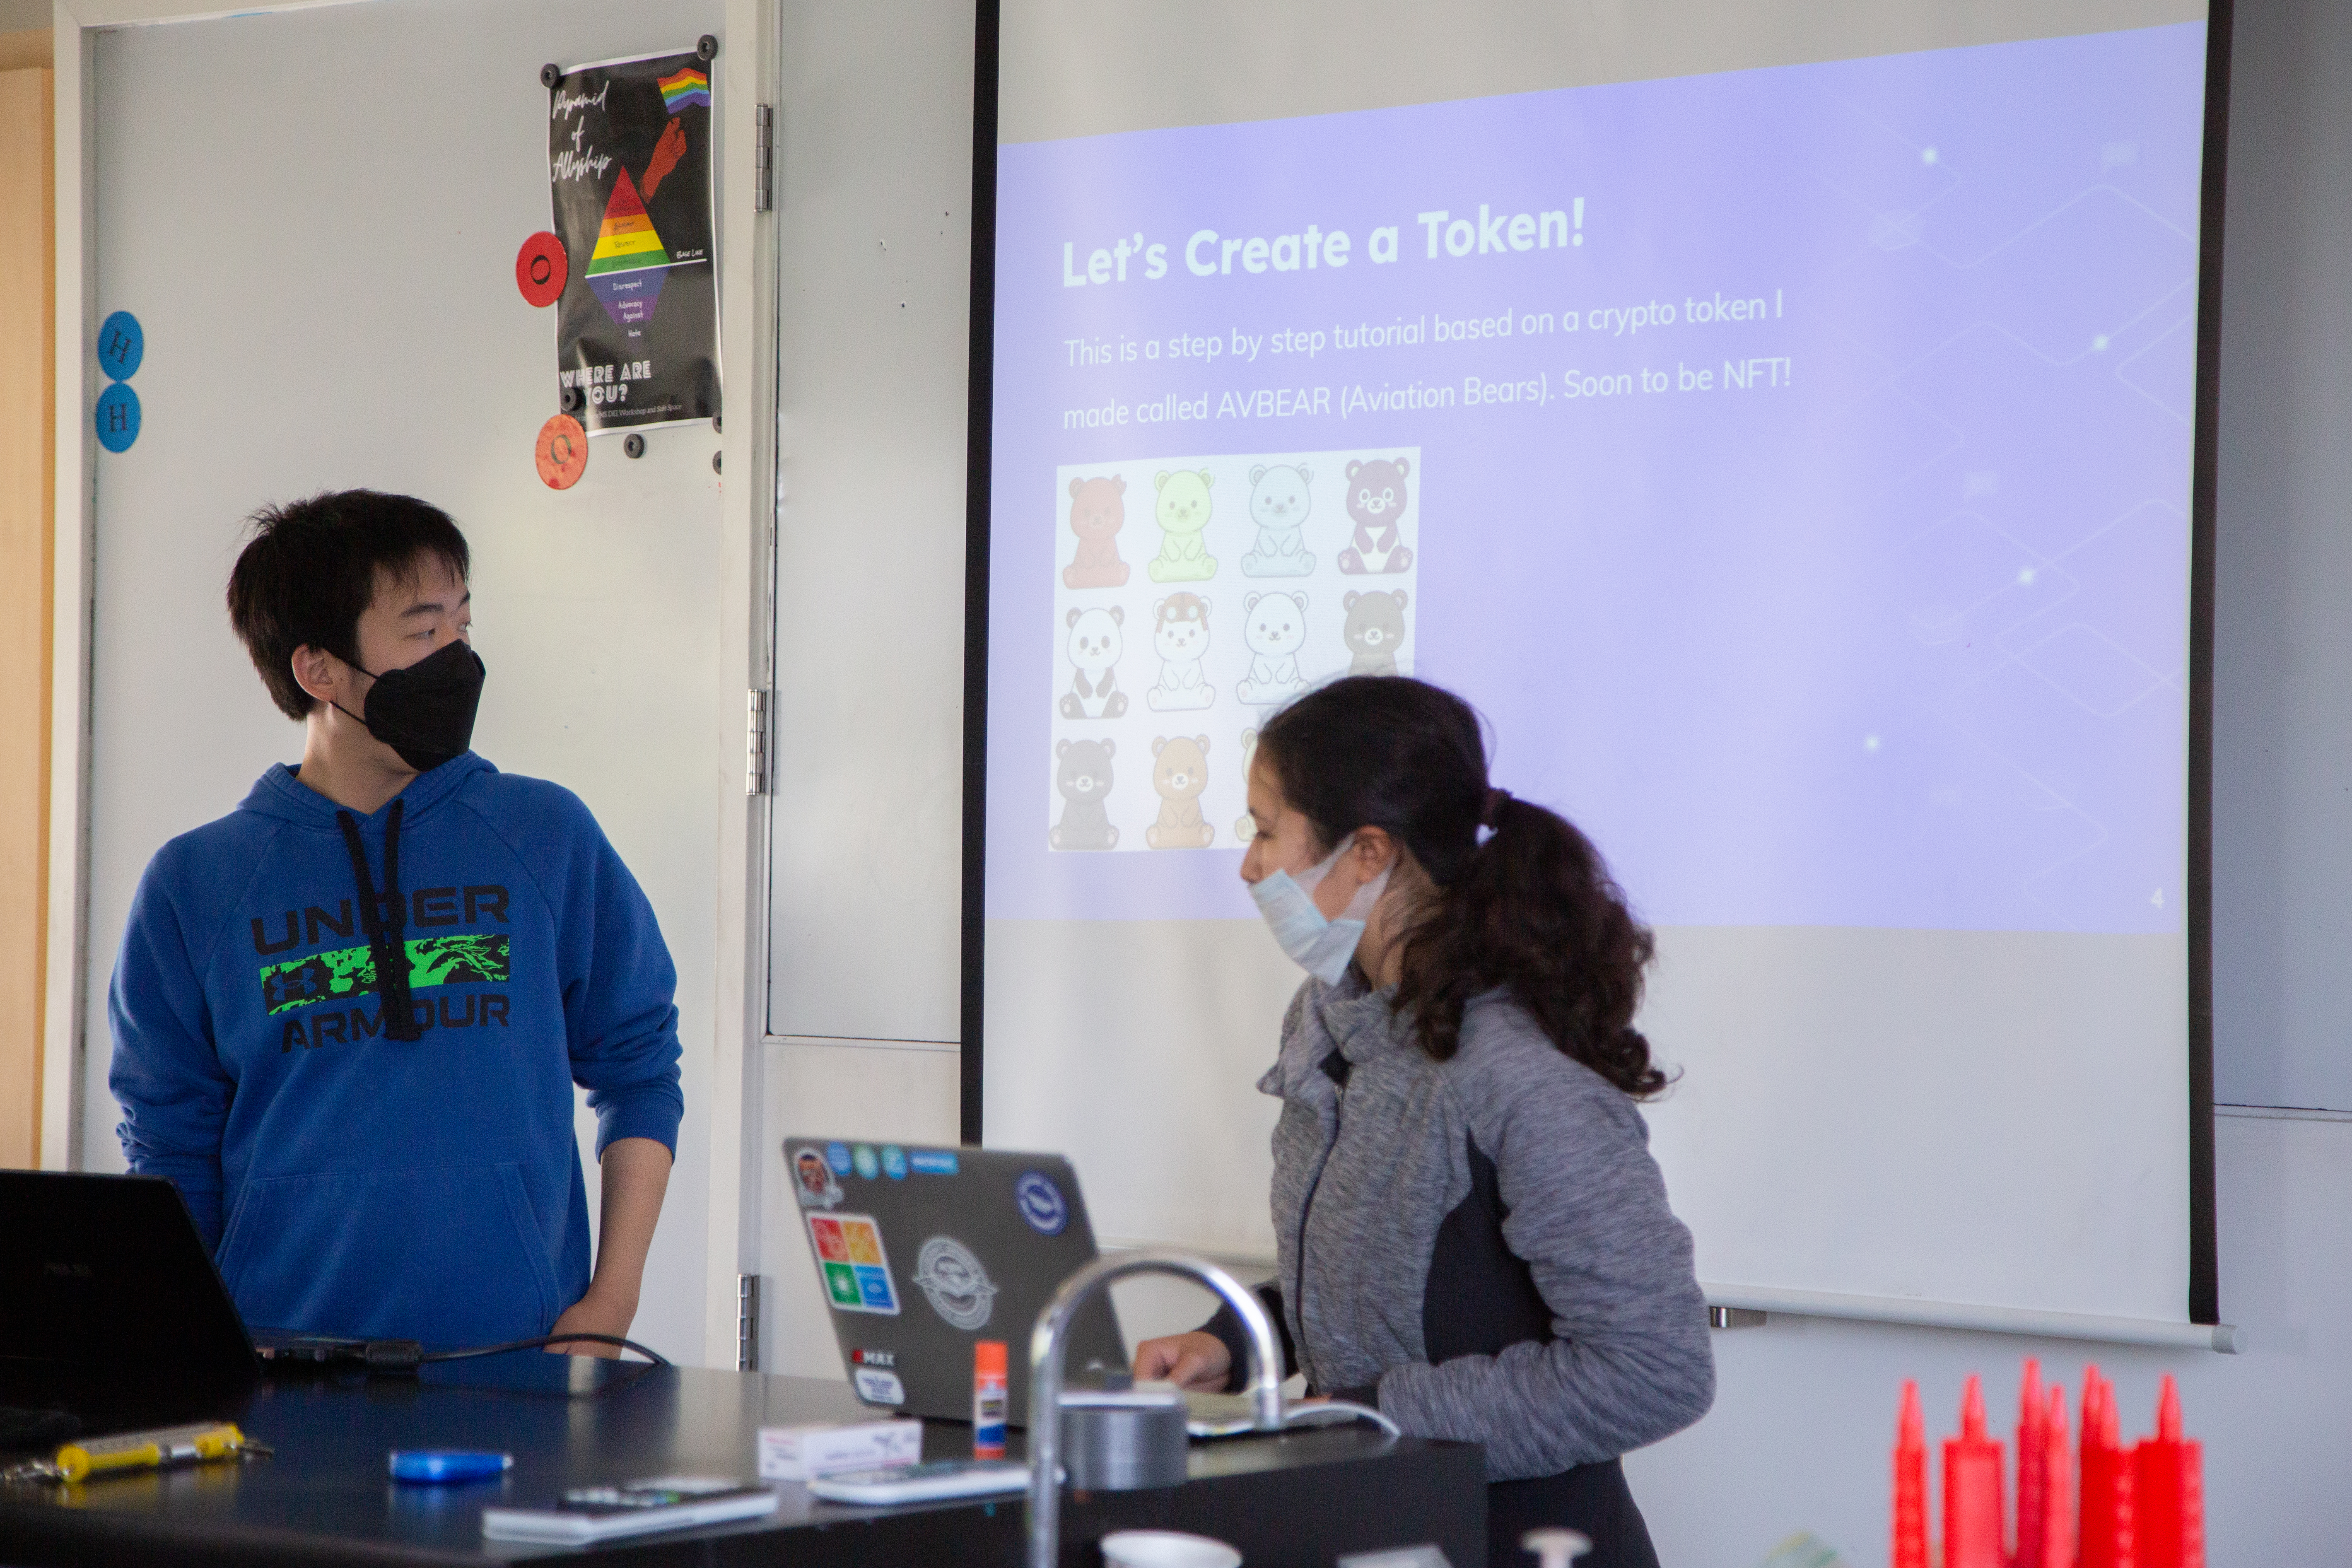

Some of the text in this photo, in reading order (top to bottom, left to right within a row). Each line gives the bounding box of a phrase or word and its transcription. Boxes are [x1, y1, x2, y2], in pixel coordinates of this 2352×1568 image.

[552, 80, 609, 120] Pyramid
[571, 115, 584, 152] of
[552, 145, 612, 182] Allyship
[1185, 225, 1351, 276] Create
[1369, 226, 1398, 263] a
[1418, 197, 1585, 259] Token!
[531, 255, 550, 285] O
[1064, 289, 1783, 367] This is a step by step tutorial based on a crypto token I
[109, 331, 131, 363] H
[560, 360, 651, 388] WHERE ARE
[584, 384, 628, 405] YOU?
[1064, 357, 1792, 429] made called AVBEAR (Aviation Bears). Soon to be NFT!
[109, 404, 127, 431] H
[551, 434, 572, 464] O
[2151, 887, 2164, 909] 4
